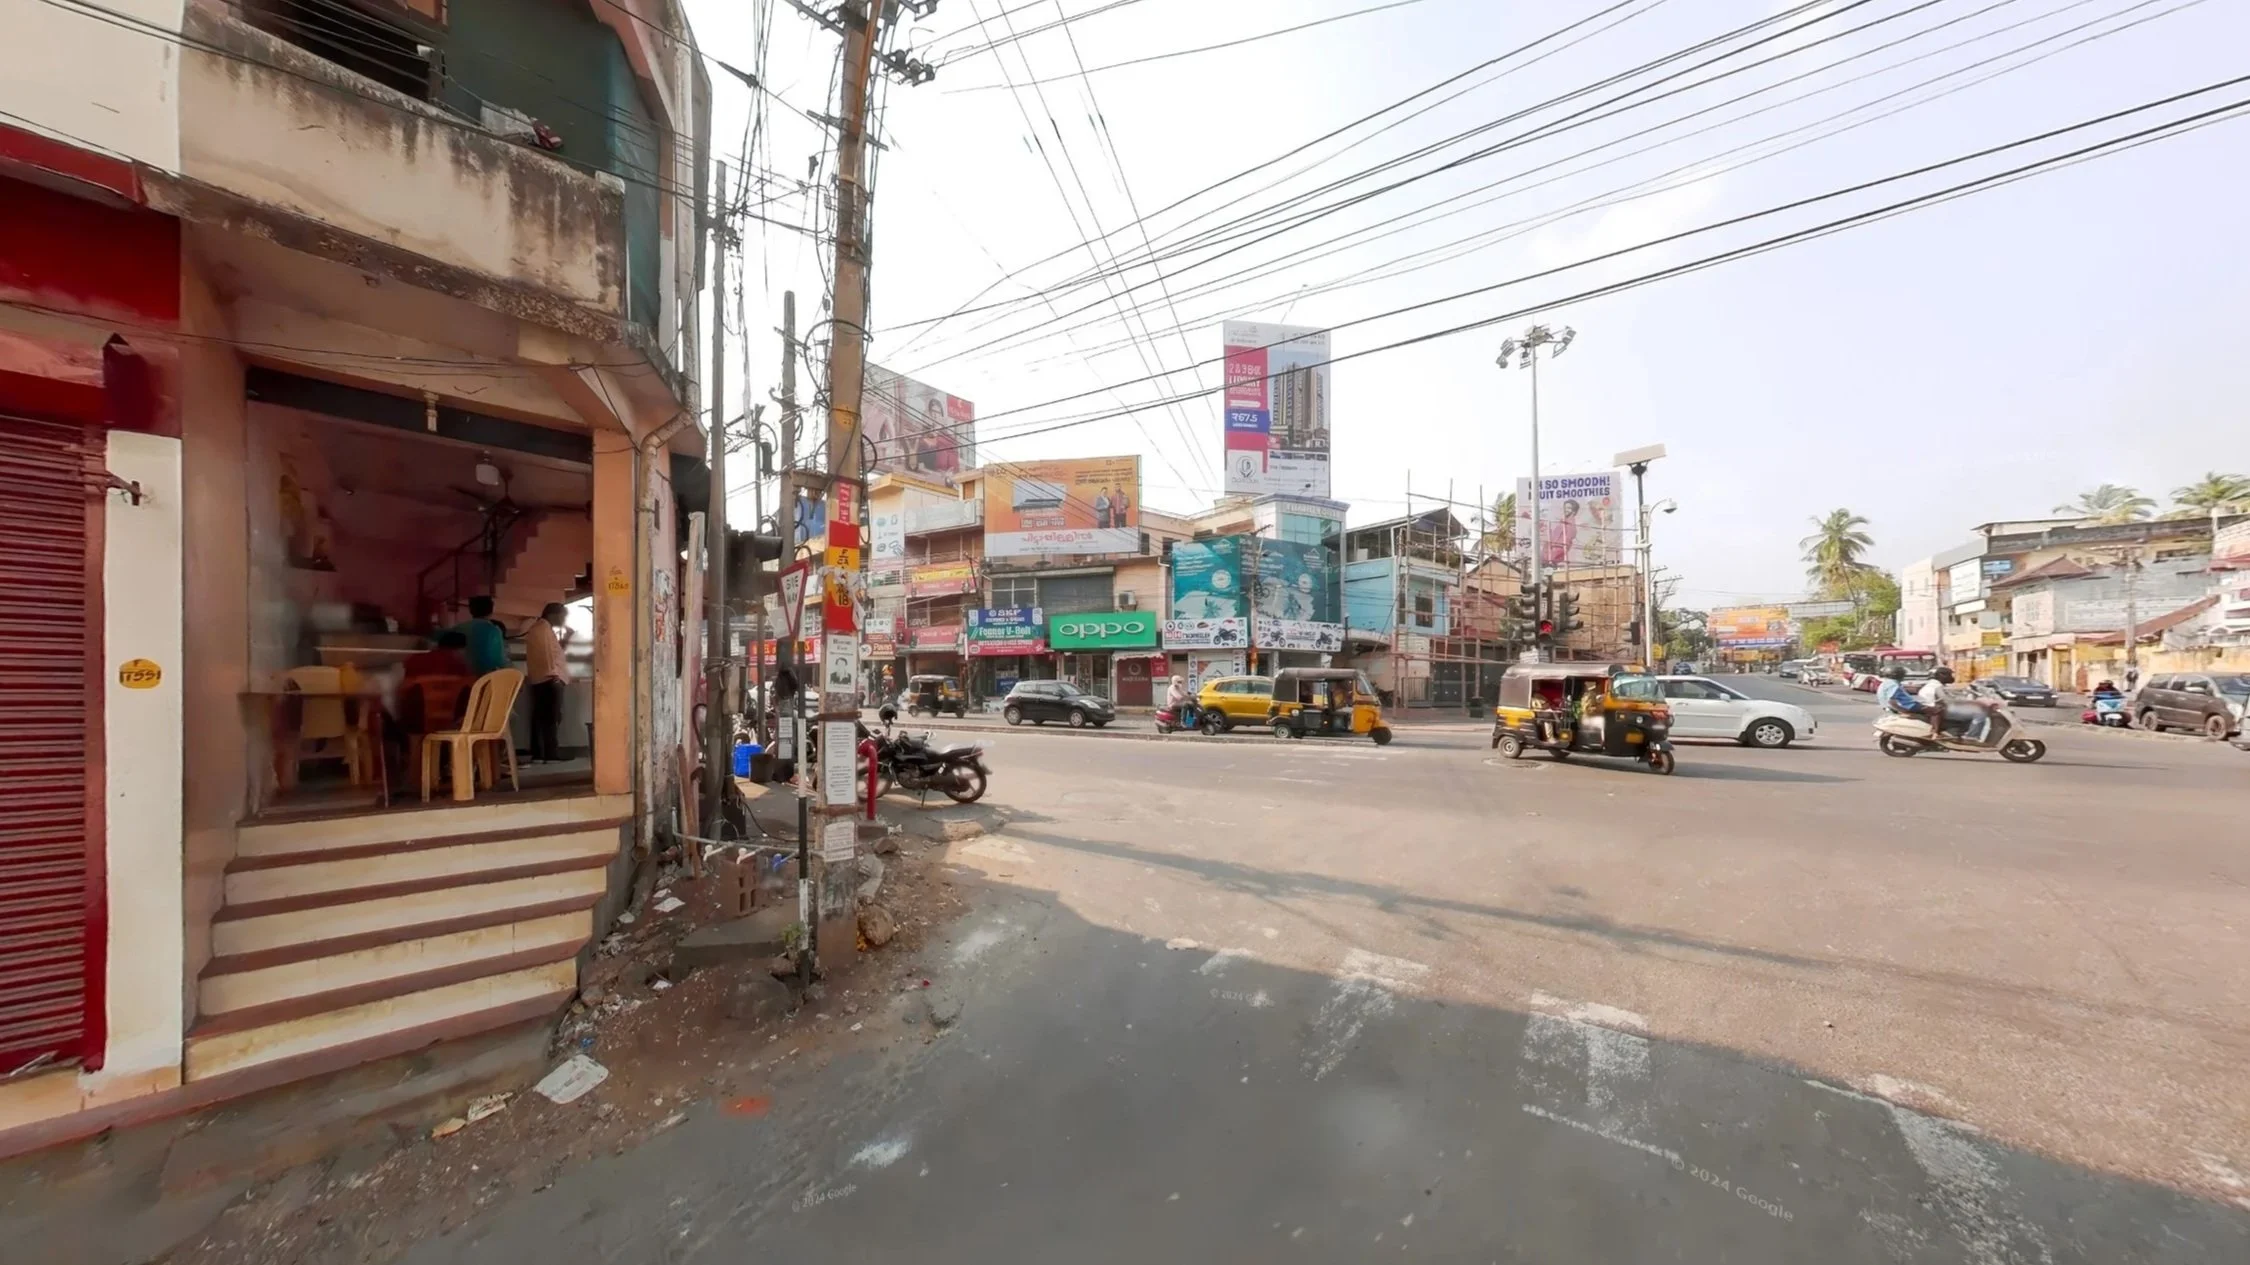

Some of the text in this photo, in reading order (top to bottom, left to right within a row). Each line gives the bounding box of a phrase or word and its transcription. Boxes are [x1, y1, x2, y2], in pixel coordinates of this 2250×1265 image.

[1546, 479, 1559, 490] SO
[1560, 475, 1611, 489] SMOODH!
[1556, 486, 1611, 499] SMOOTHIES
